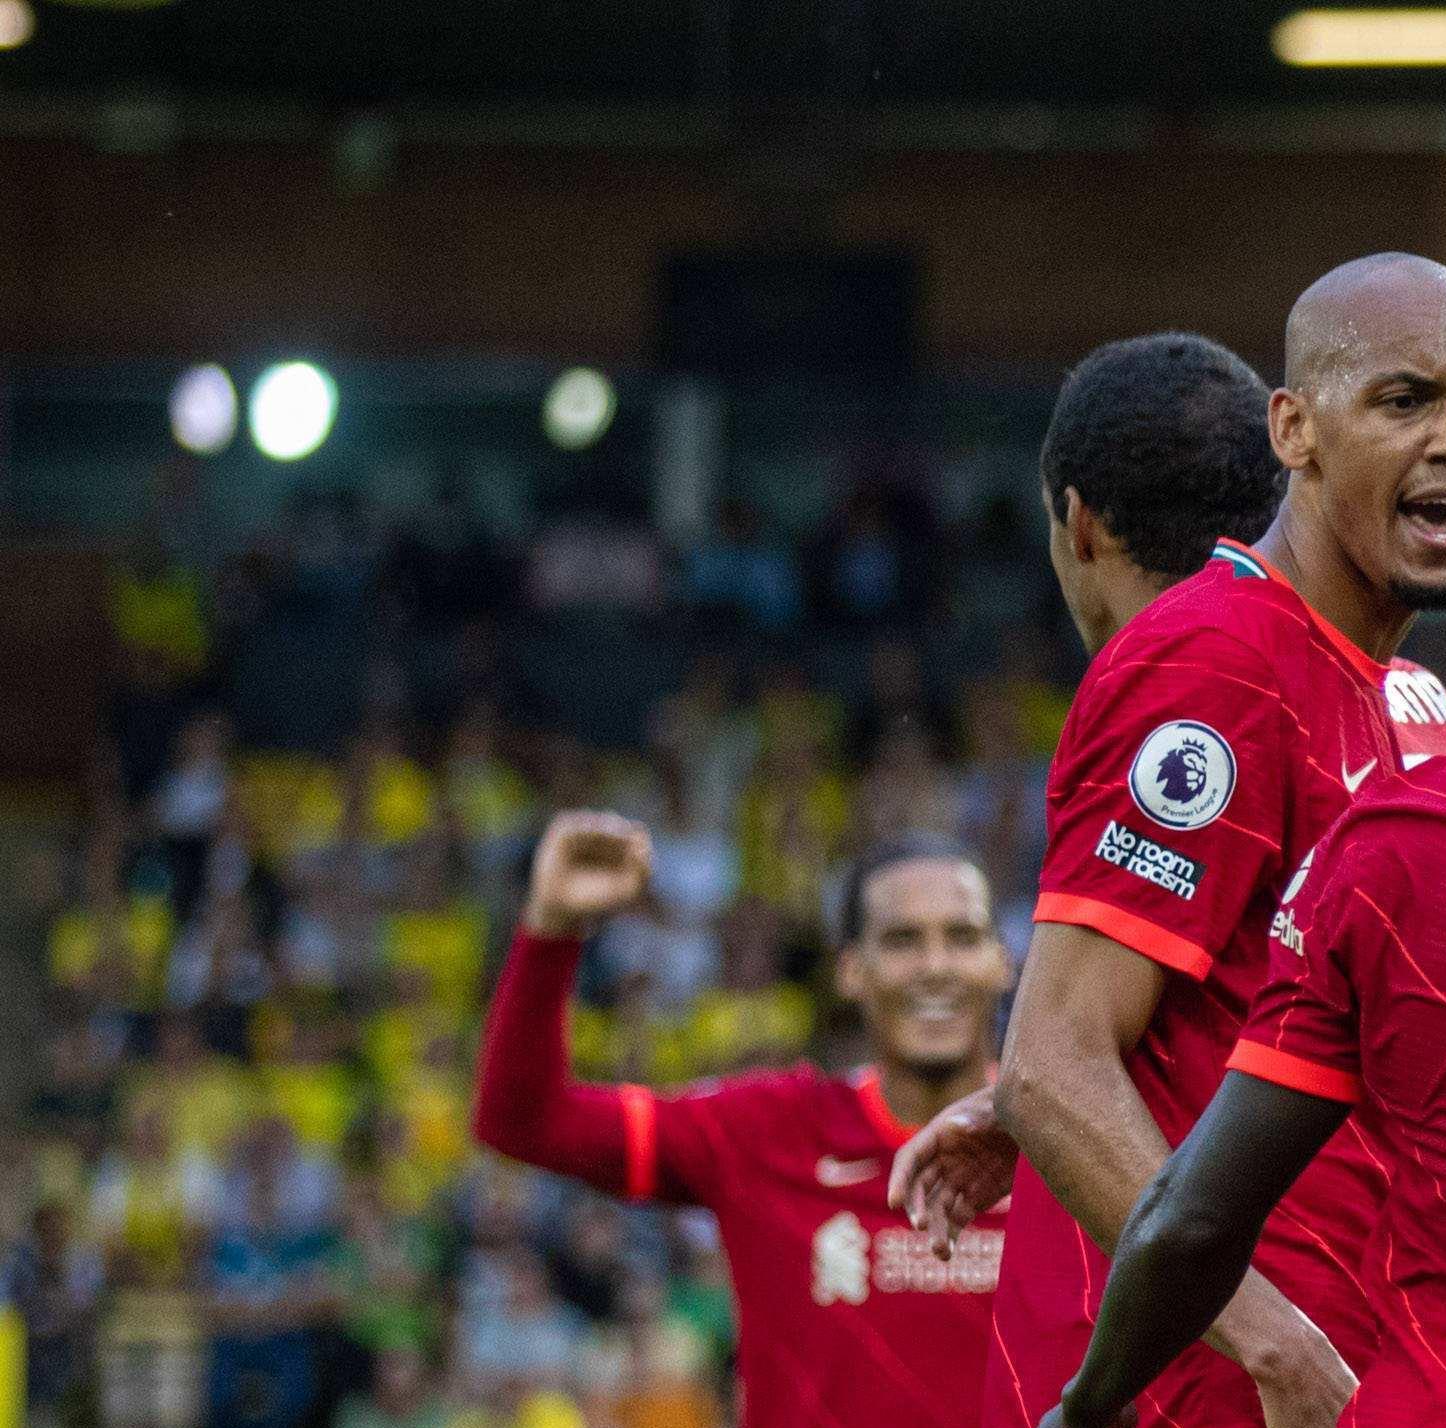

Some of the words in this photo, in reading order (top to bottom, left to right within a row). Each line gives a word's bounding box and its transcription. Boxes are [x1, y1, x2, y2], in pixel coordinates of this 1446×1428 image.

[1102, 819, 1137, 851] No
[1136, 837, 1195, 880] room
[1126, 854, 1197, 901] racism
